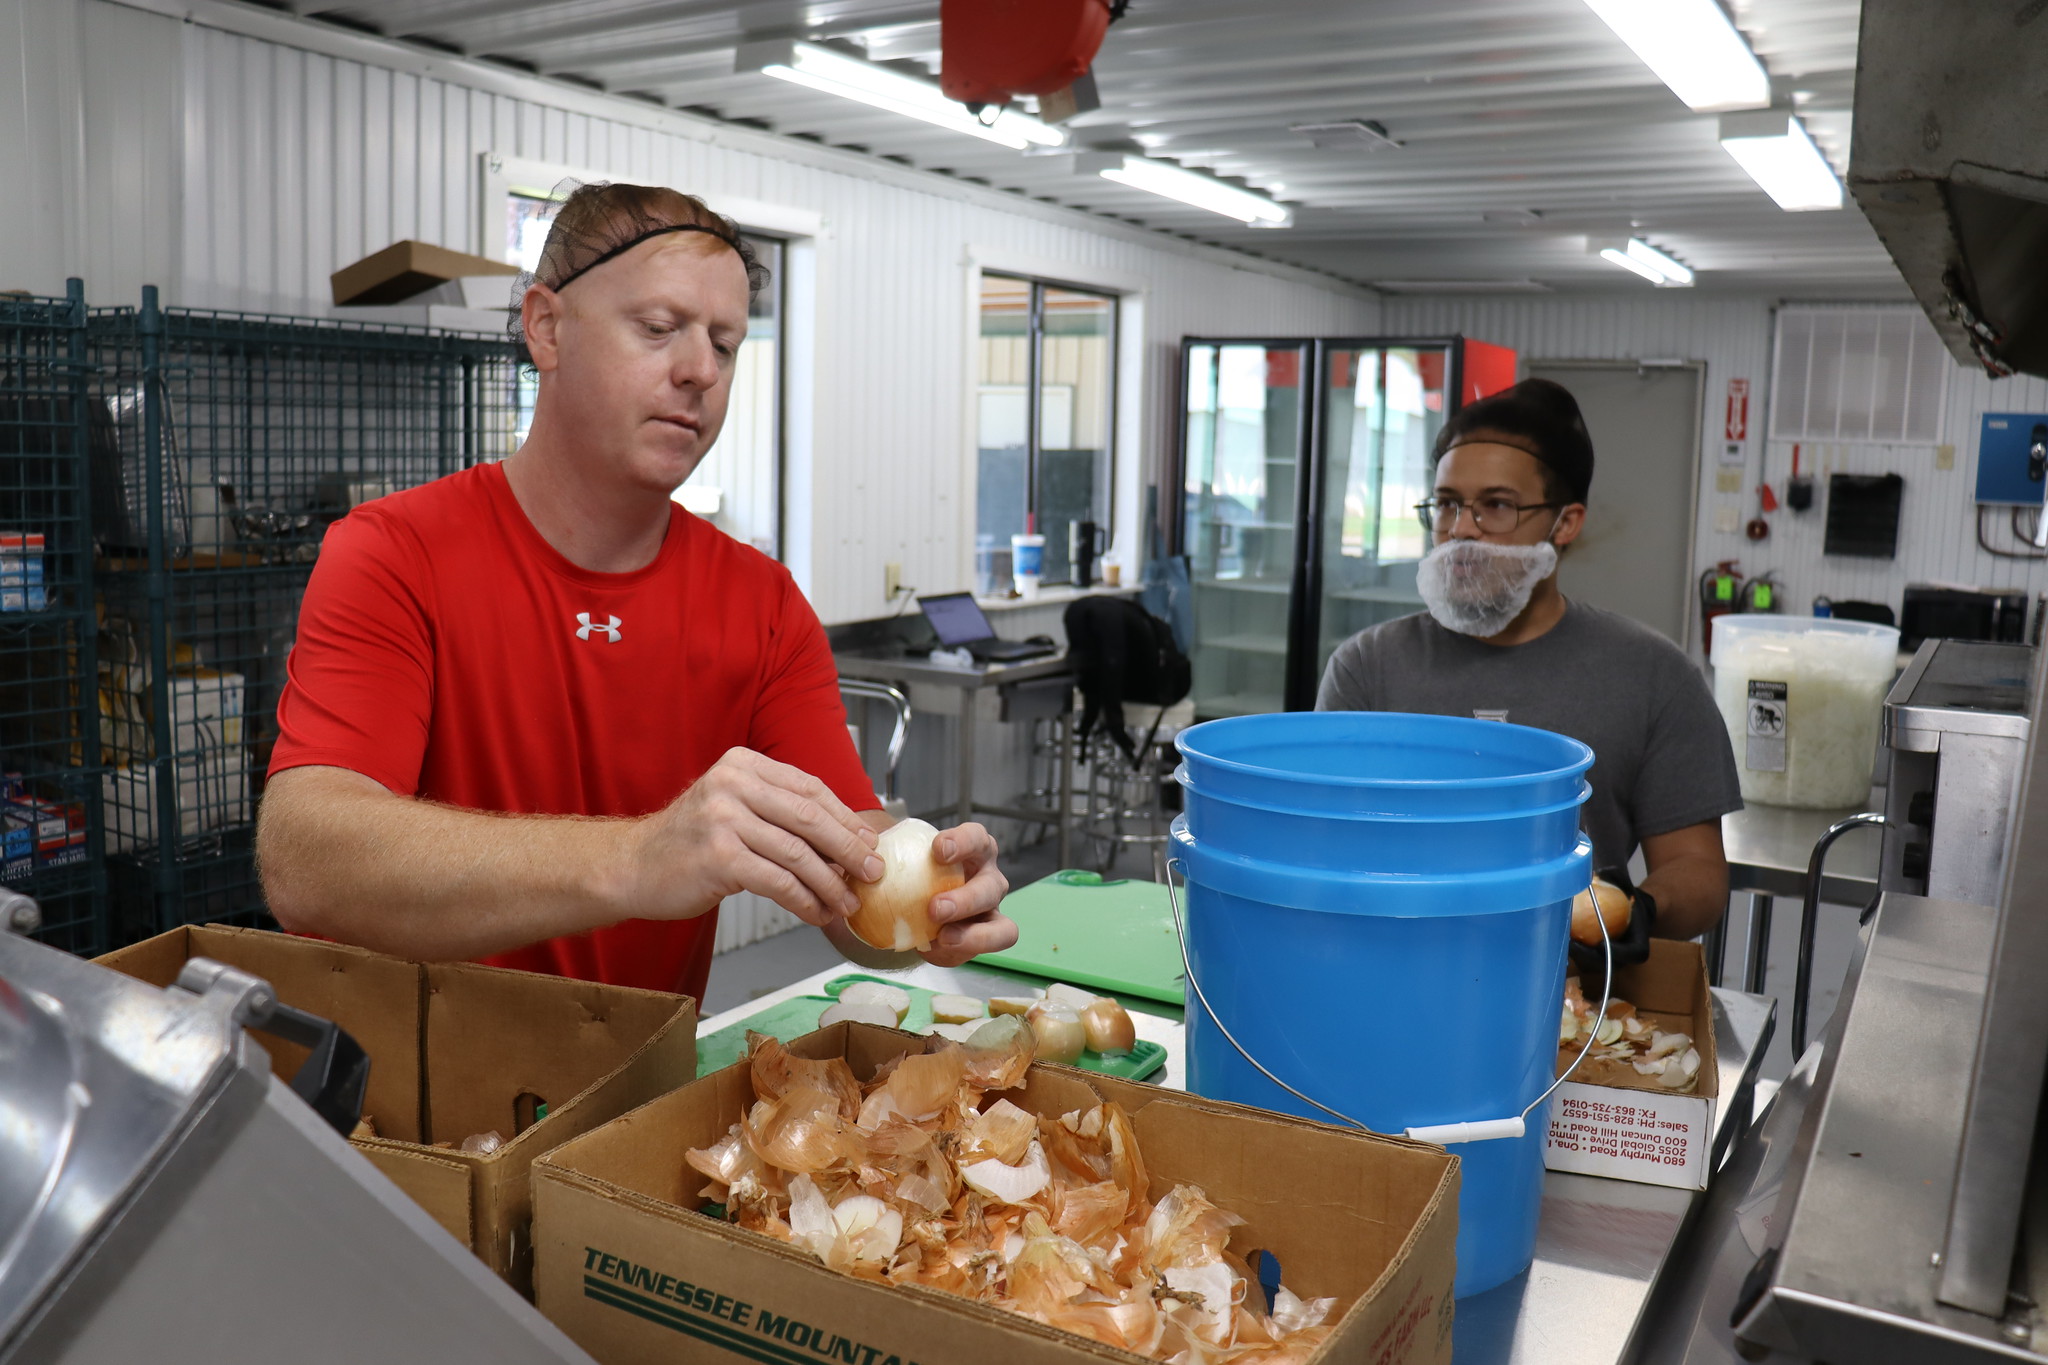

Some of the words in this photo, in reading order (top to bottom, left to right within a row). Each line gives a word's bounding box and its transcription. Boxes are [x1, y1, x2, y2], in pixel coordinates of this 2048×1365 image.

[1562, 1098, 1636, 1116] 863-735-0194
[1562, 1108, 1634, 1126] 828-551-6557
[1638, 1108, 1656, 1119] FX:
[1570, 1123, 1598, 1135] Road
[1637, 1118, 1655, 1129] PH:
[1657, 1121, 1689, 1133] Sales:
[1601, 1128, 1618, 1138] Hill
[1621, 1130, 1661, 1144] Duncan
[1555, 1139, 1579, 1151] Ona,
[1590, 1136, 1617, 1147] Drive
[1620, 1140, 1656, 1152] Global
[1664, 1137, 1687, 1147] 600
[1590, 1145, 1617, 1157] Road
[1620, 1149, 1661, 1163] Murphy
[1658, 1146, 1687, 1157] 2055
[1663, 1156, 1686, 1167] 680
[583, 1246, 753, 1328] TENNESSEE
[755, 1309, 921, 1365] MOUNT
